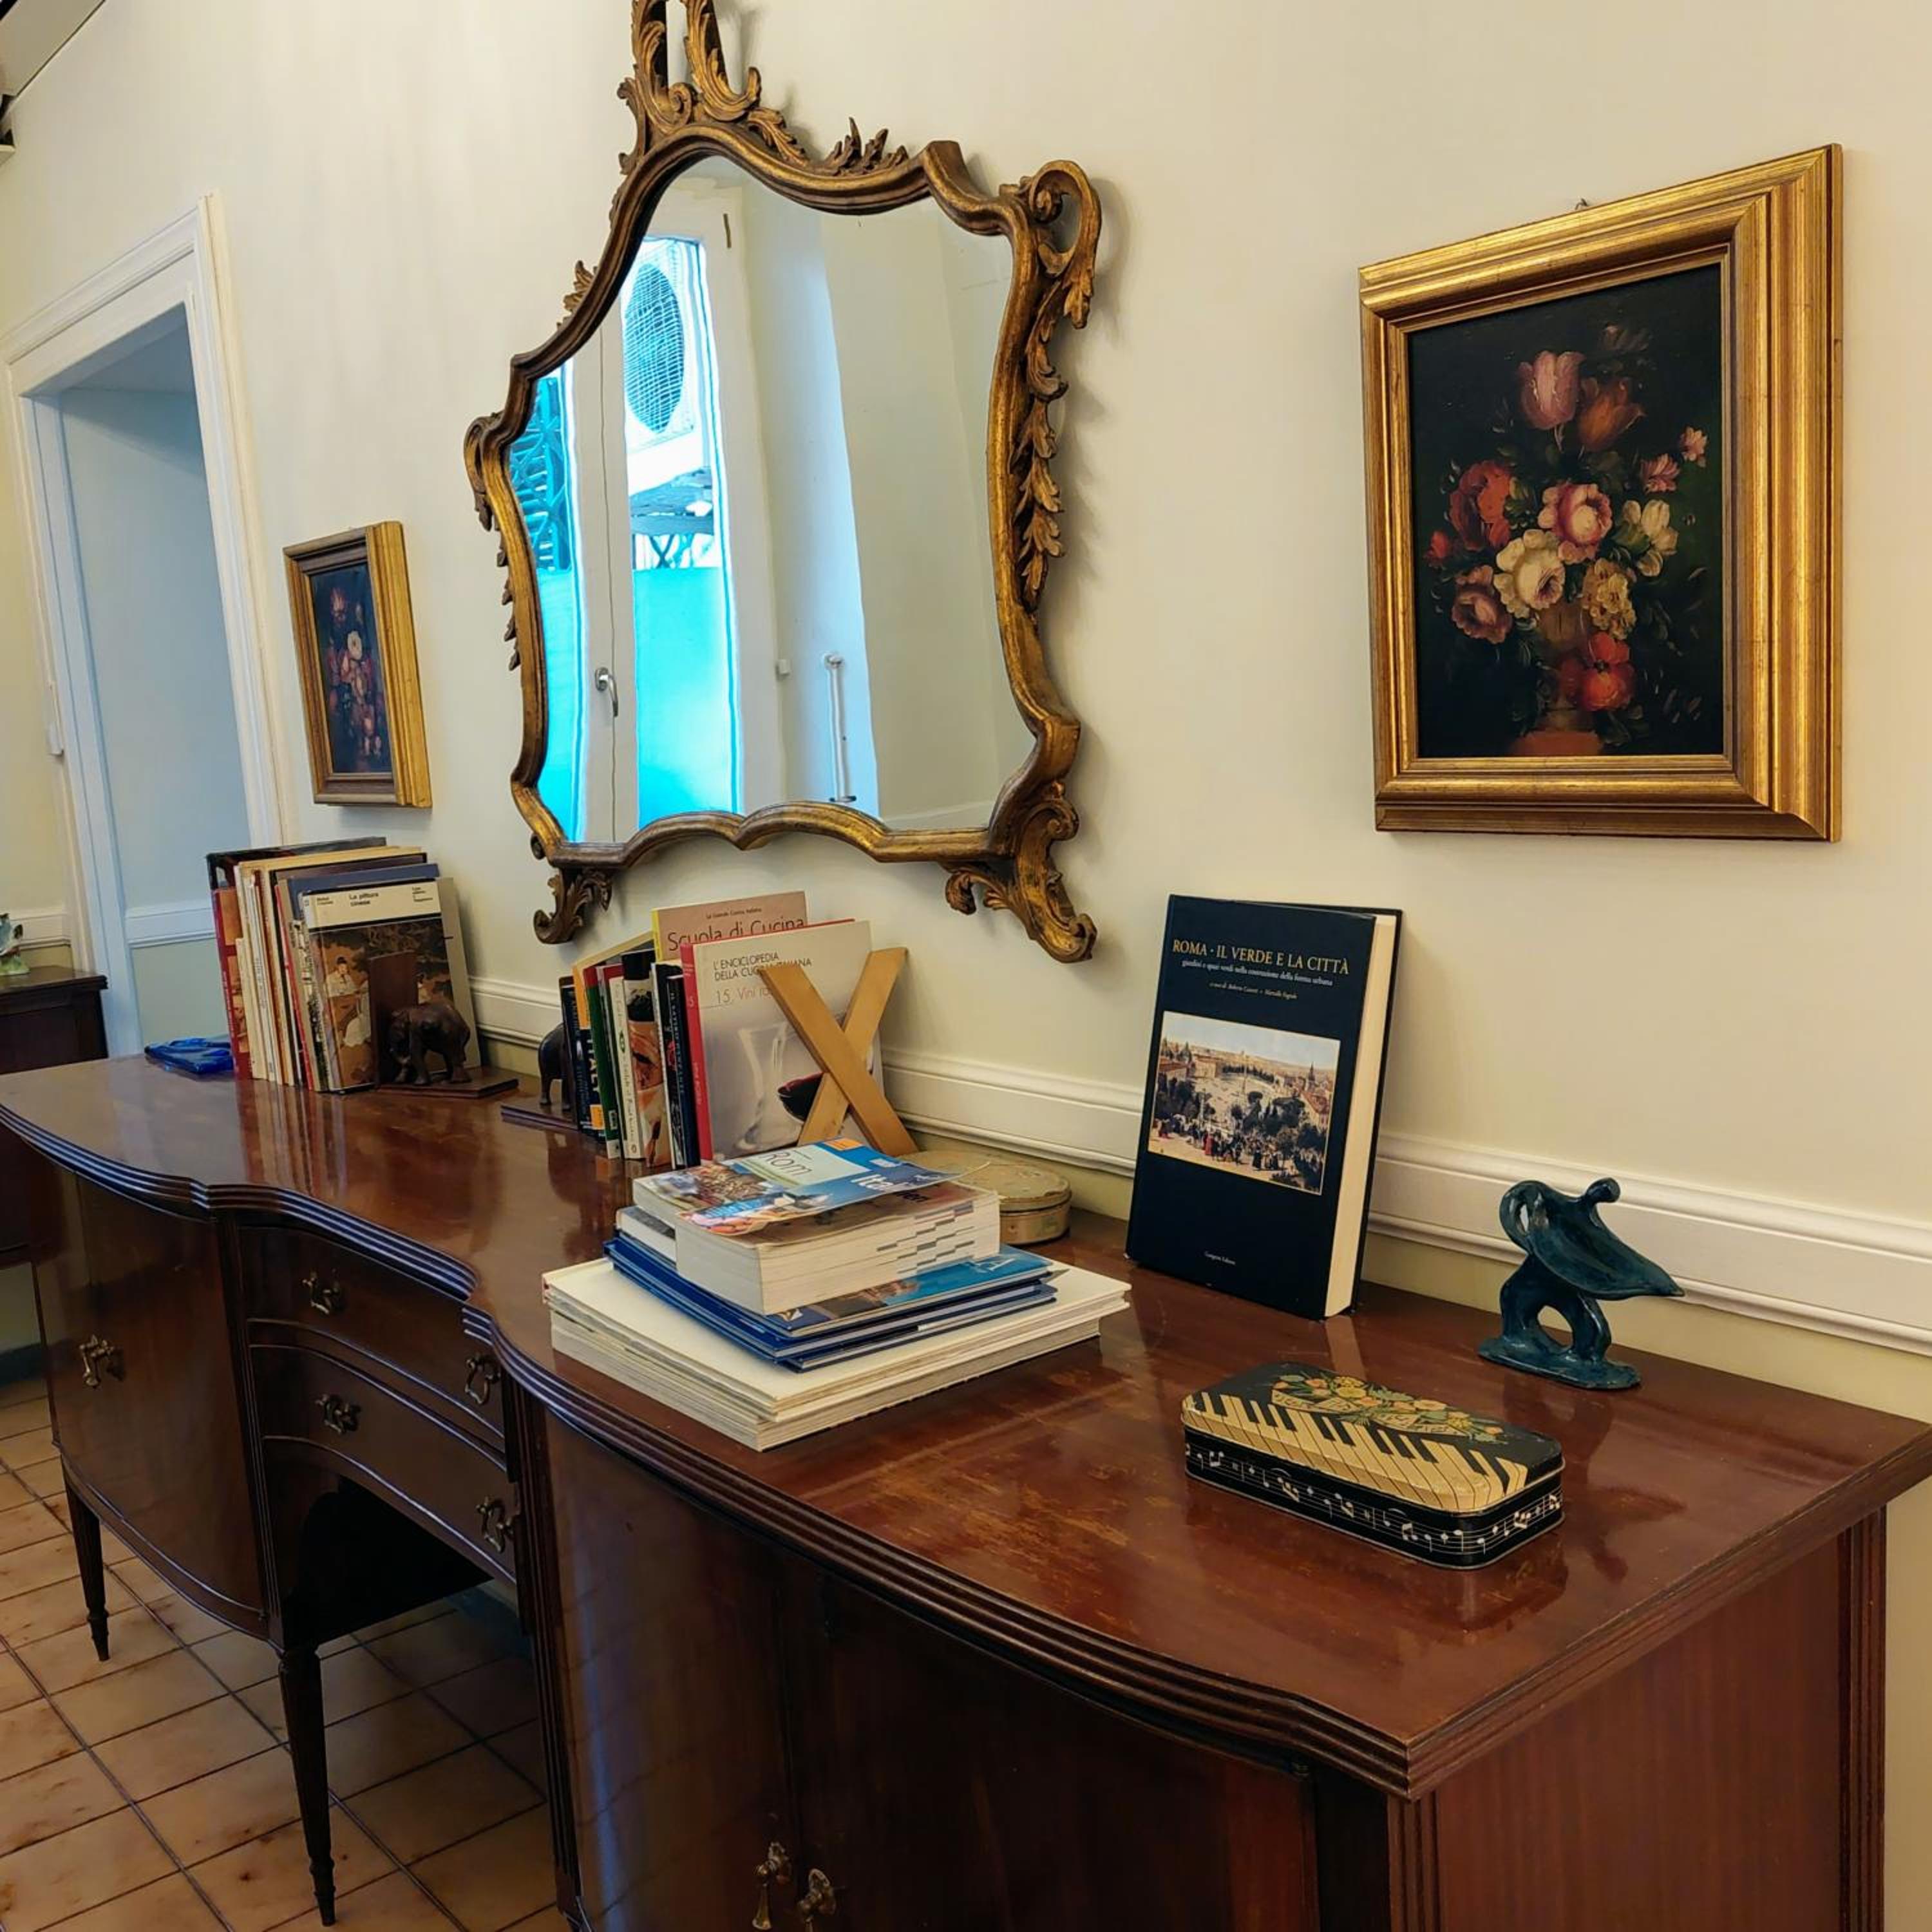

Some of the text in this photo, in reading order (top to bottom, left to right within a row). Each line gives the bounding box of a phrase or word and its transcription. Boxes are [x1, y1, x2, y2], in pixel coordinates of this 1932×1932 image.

[667, 925, 723, 951] Scuola
[730, 920, 743, 937] di
[1172, 939, 1350, 974] ROMA IL VERDE E LA CITTÀ
[714, 970, 739, 981] DELLA
[737, 988, 757, 1000] Vini
[759, 1151, 813, 1176] Rom
